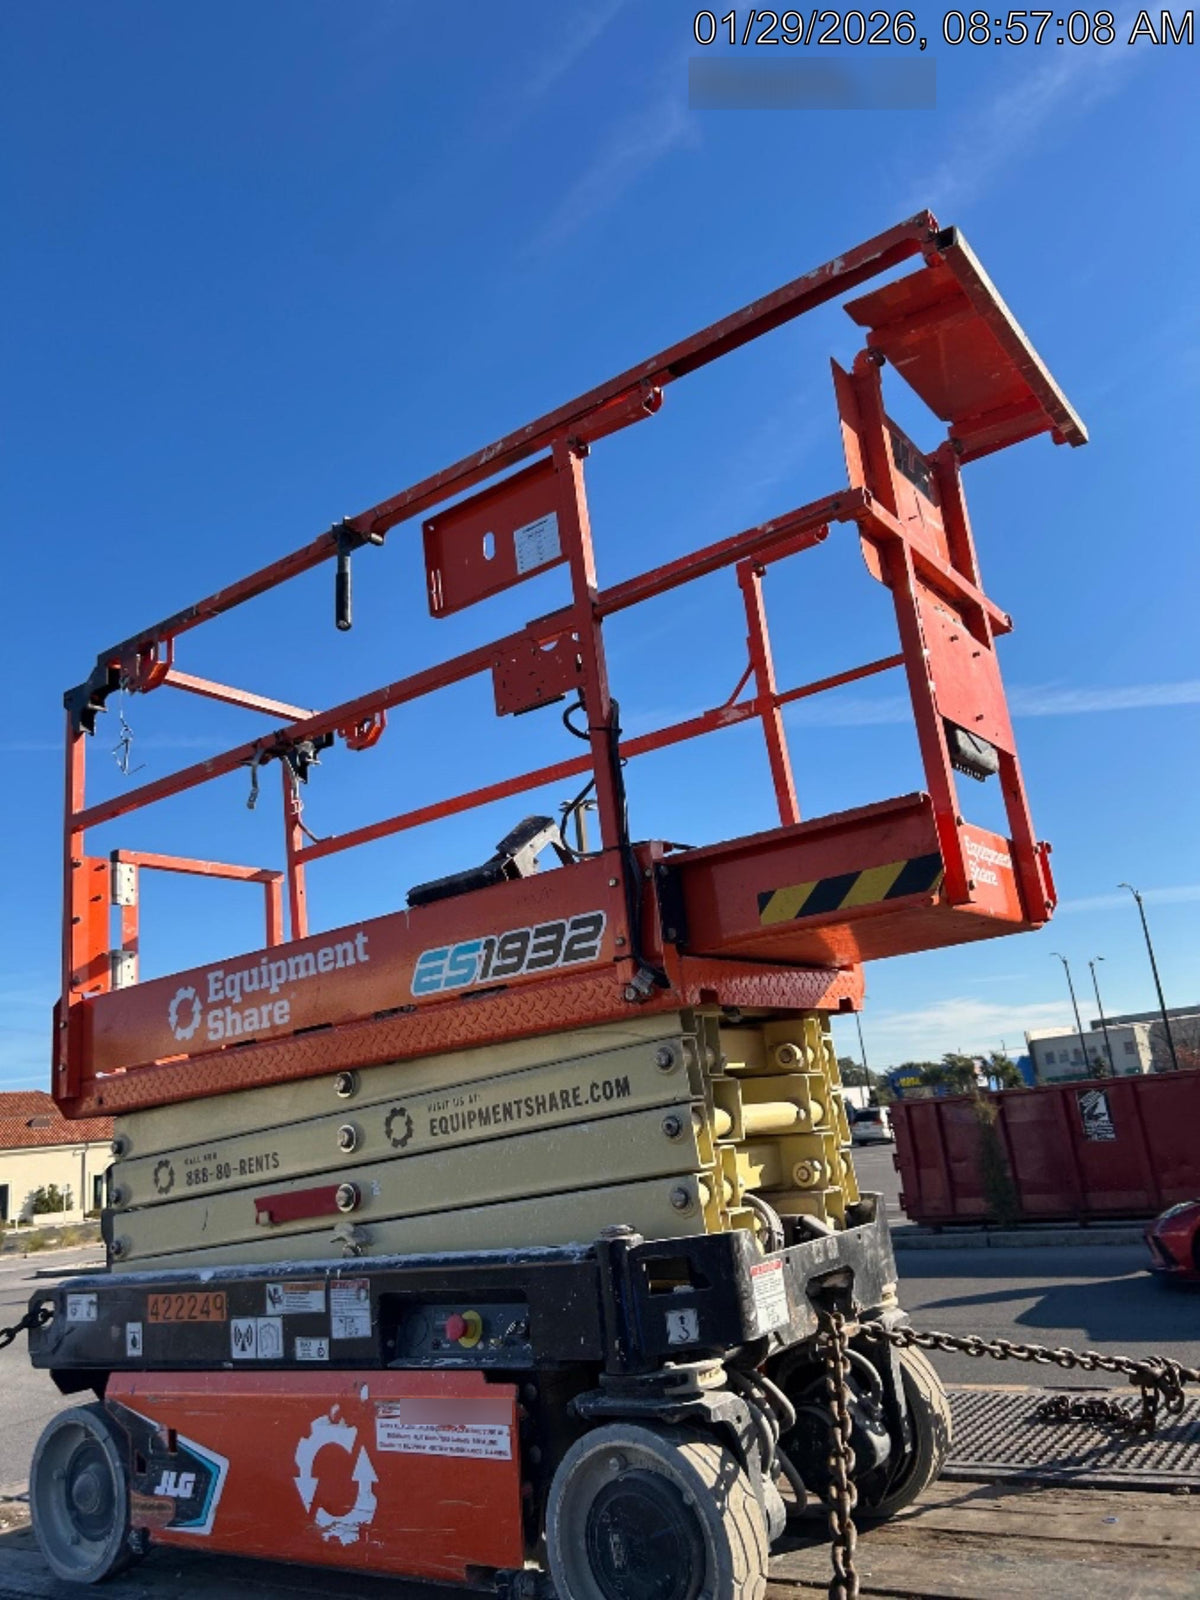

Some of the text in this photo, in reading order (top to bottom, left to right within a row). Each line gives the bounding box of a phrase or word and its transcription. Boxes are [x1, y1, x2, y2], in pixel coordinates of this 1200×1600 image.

[207, 931, 370, 1004] Equipment
[410, 910, 607, 997] ES1932
[207, 998, 290, 1042] Share
[429, 1075, 631, 1137] EQUIPMENTSHARE.COM
[150, 1294, 225, 1321] 422249
[154, 1470, 196, 1498] JLG
